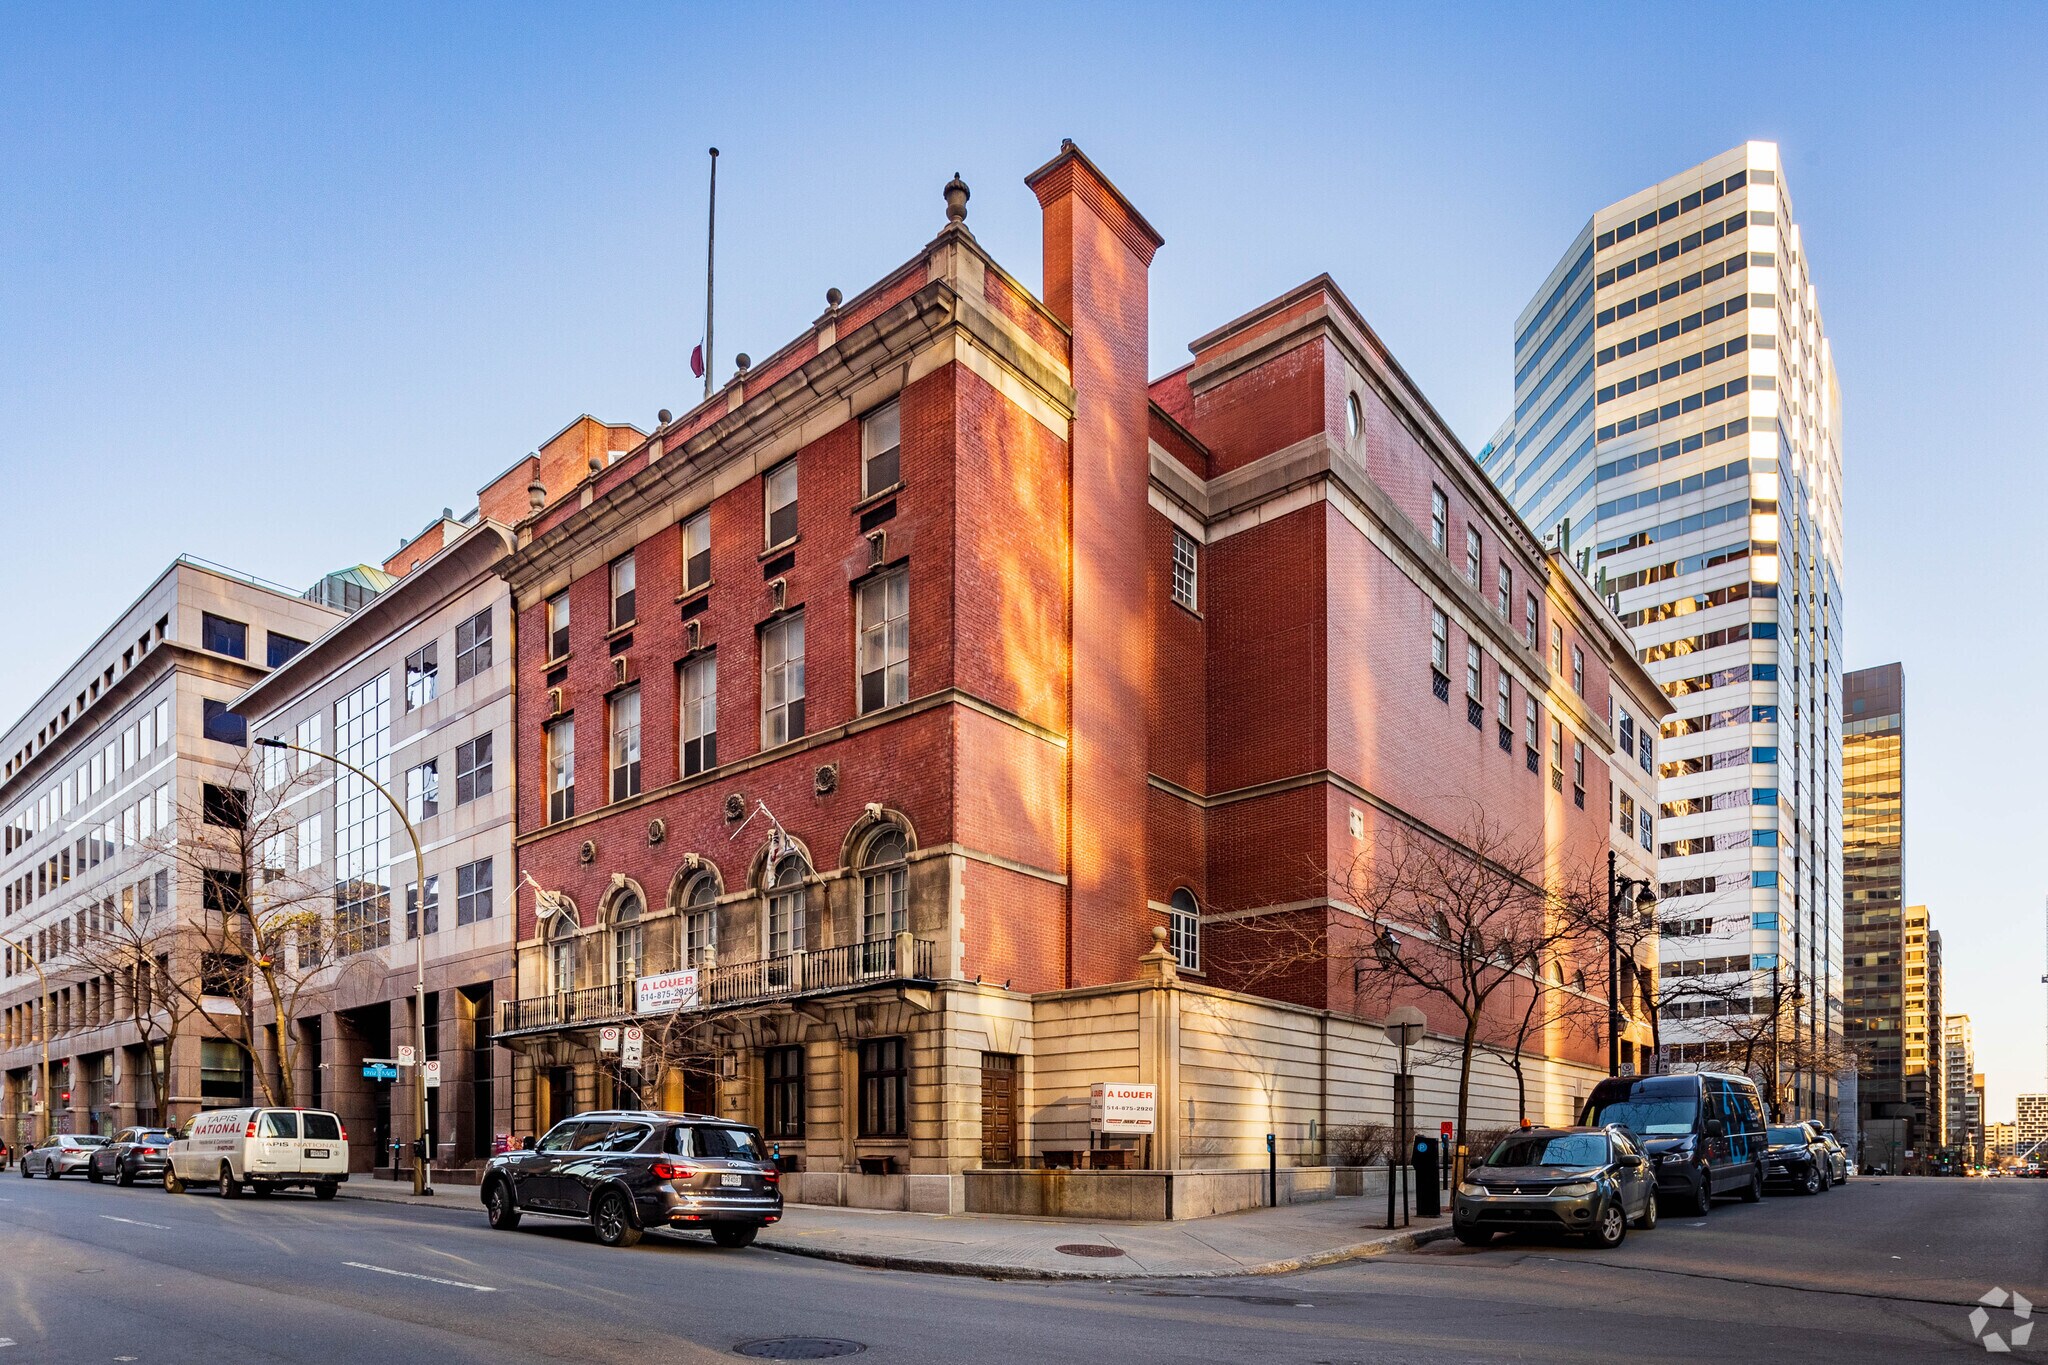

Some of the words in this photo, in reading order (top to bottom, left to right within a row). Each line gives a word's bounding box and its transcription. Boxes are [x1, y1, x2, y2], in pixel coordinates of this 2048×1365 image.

[641, 983, 649, 992] A
[652, 976, 694, 990] LOUER
[1107, 1090, 1115, 1098] A
[1117, 1091, 1153, 1099] LOUER
[207, 1114, 238, 1123] TAPIS
[195, 1122, 241, 1135] NATIONAL
